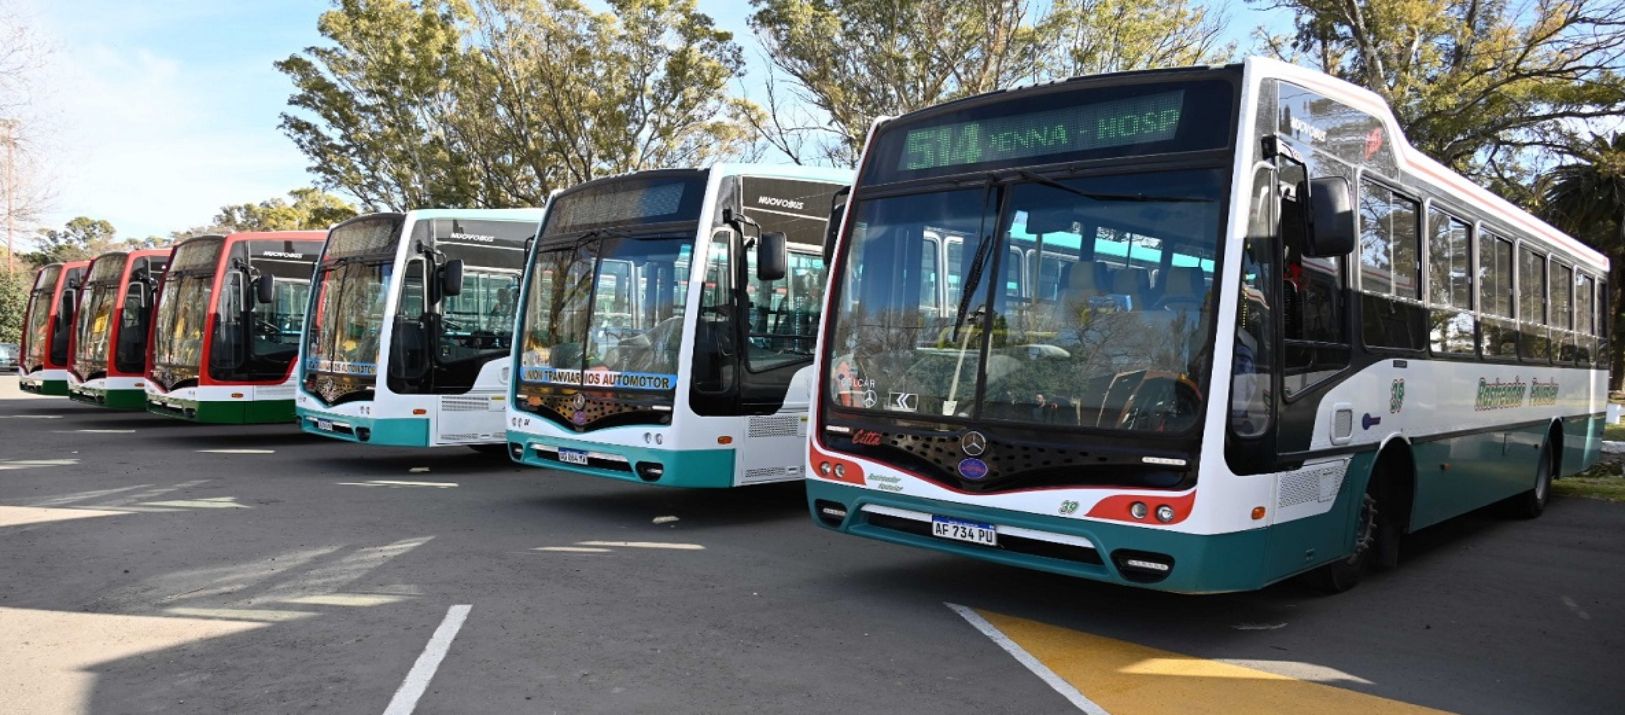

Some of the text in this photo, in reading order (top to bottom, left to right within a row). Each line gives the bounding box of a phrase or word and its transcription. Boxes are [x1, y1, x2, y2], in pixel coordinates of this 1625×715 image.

[907, 122, 981, 170] 514
[1098, 109, 1180, 139] HOSP
[758, 196, 804, 209] NUOVOBUS
[603, 373, 669, 389] AUTOMOTOR
[1058, 500, 1079, 514] 39
[935, 522, 948, 535] AF
[953, 525, 974, 540] 734
[978, 529, 993, 543] PU
